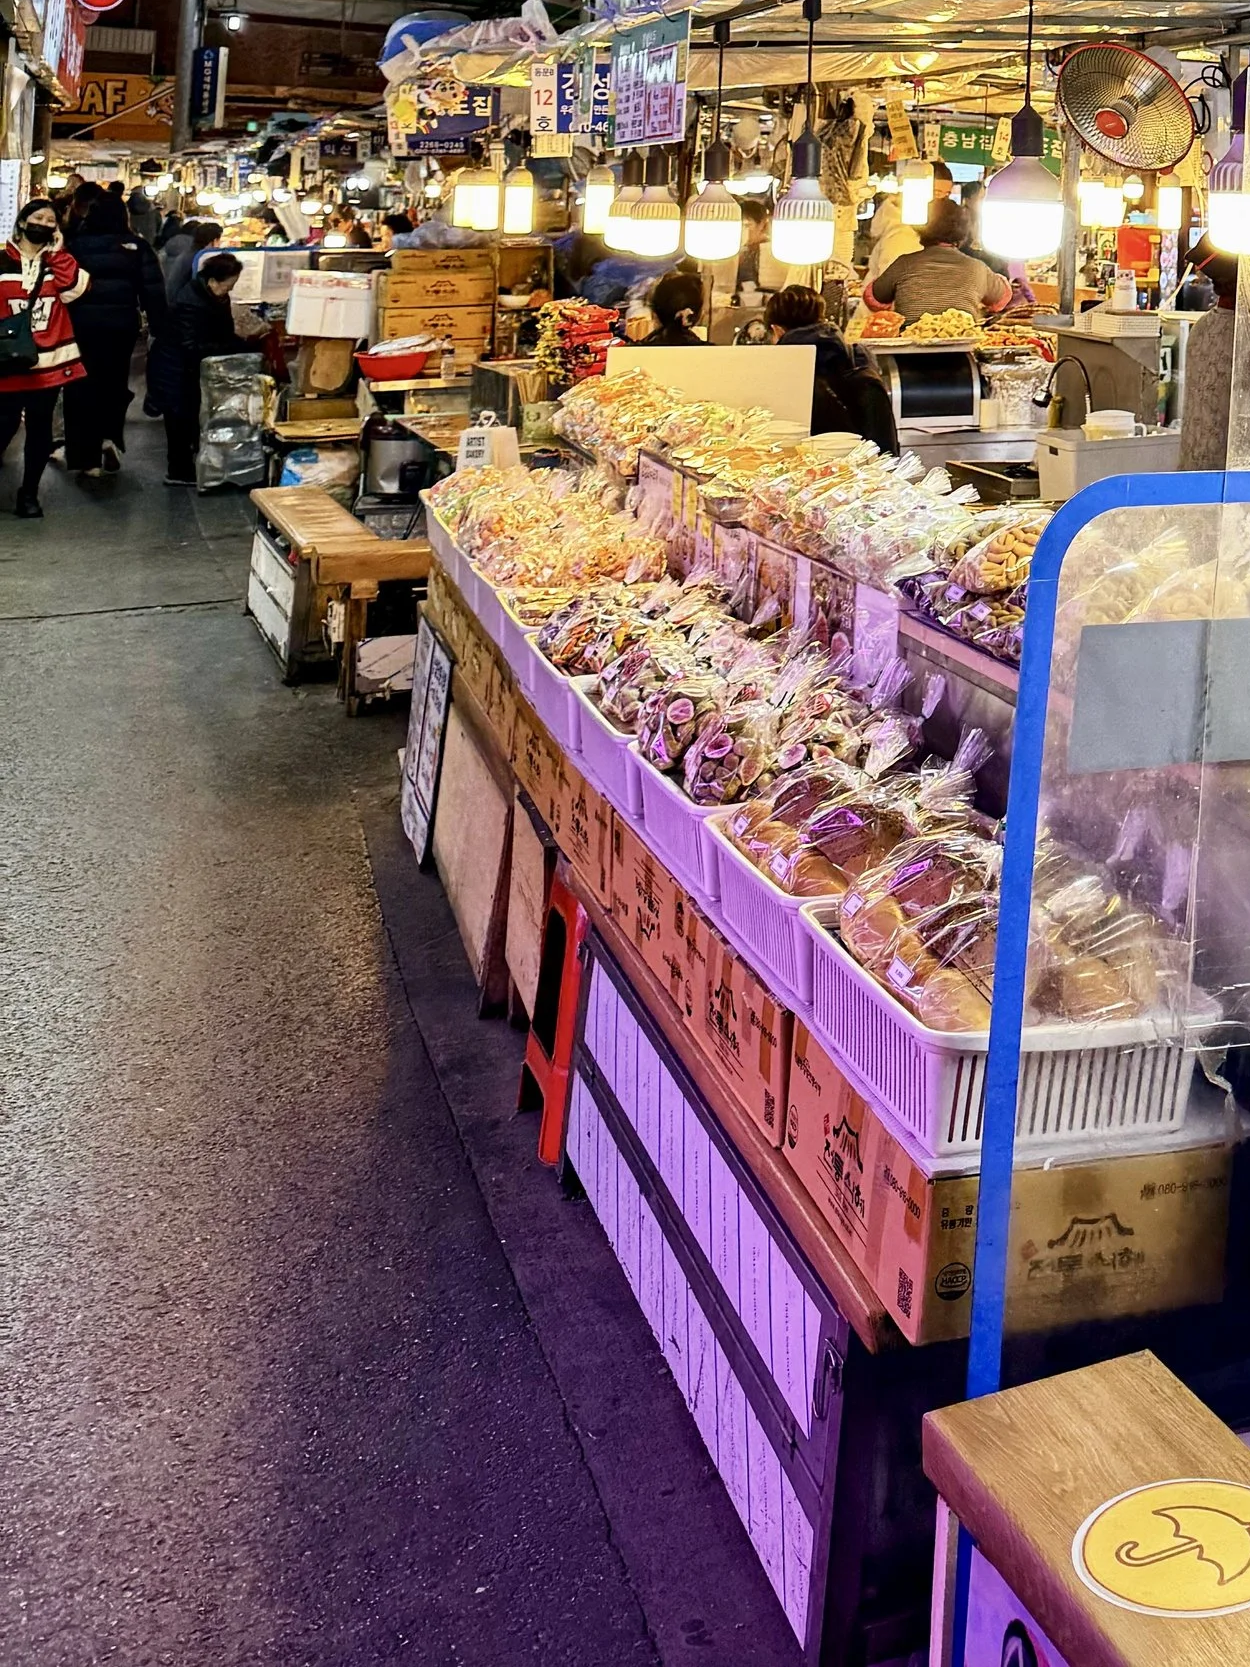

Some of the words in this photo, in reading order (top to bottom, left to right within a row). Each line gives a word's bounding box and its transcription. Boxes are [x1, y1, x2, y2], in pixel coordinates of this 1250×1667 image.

[534, 89, 553, 106] 12
[534, 116, 553, 132] 호
[942, 1275, 968, 1286] HACCP
